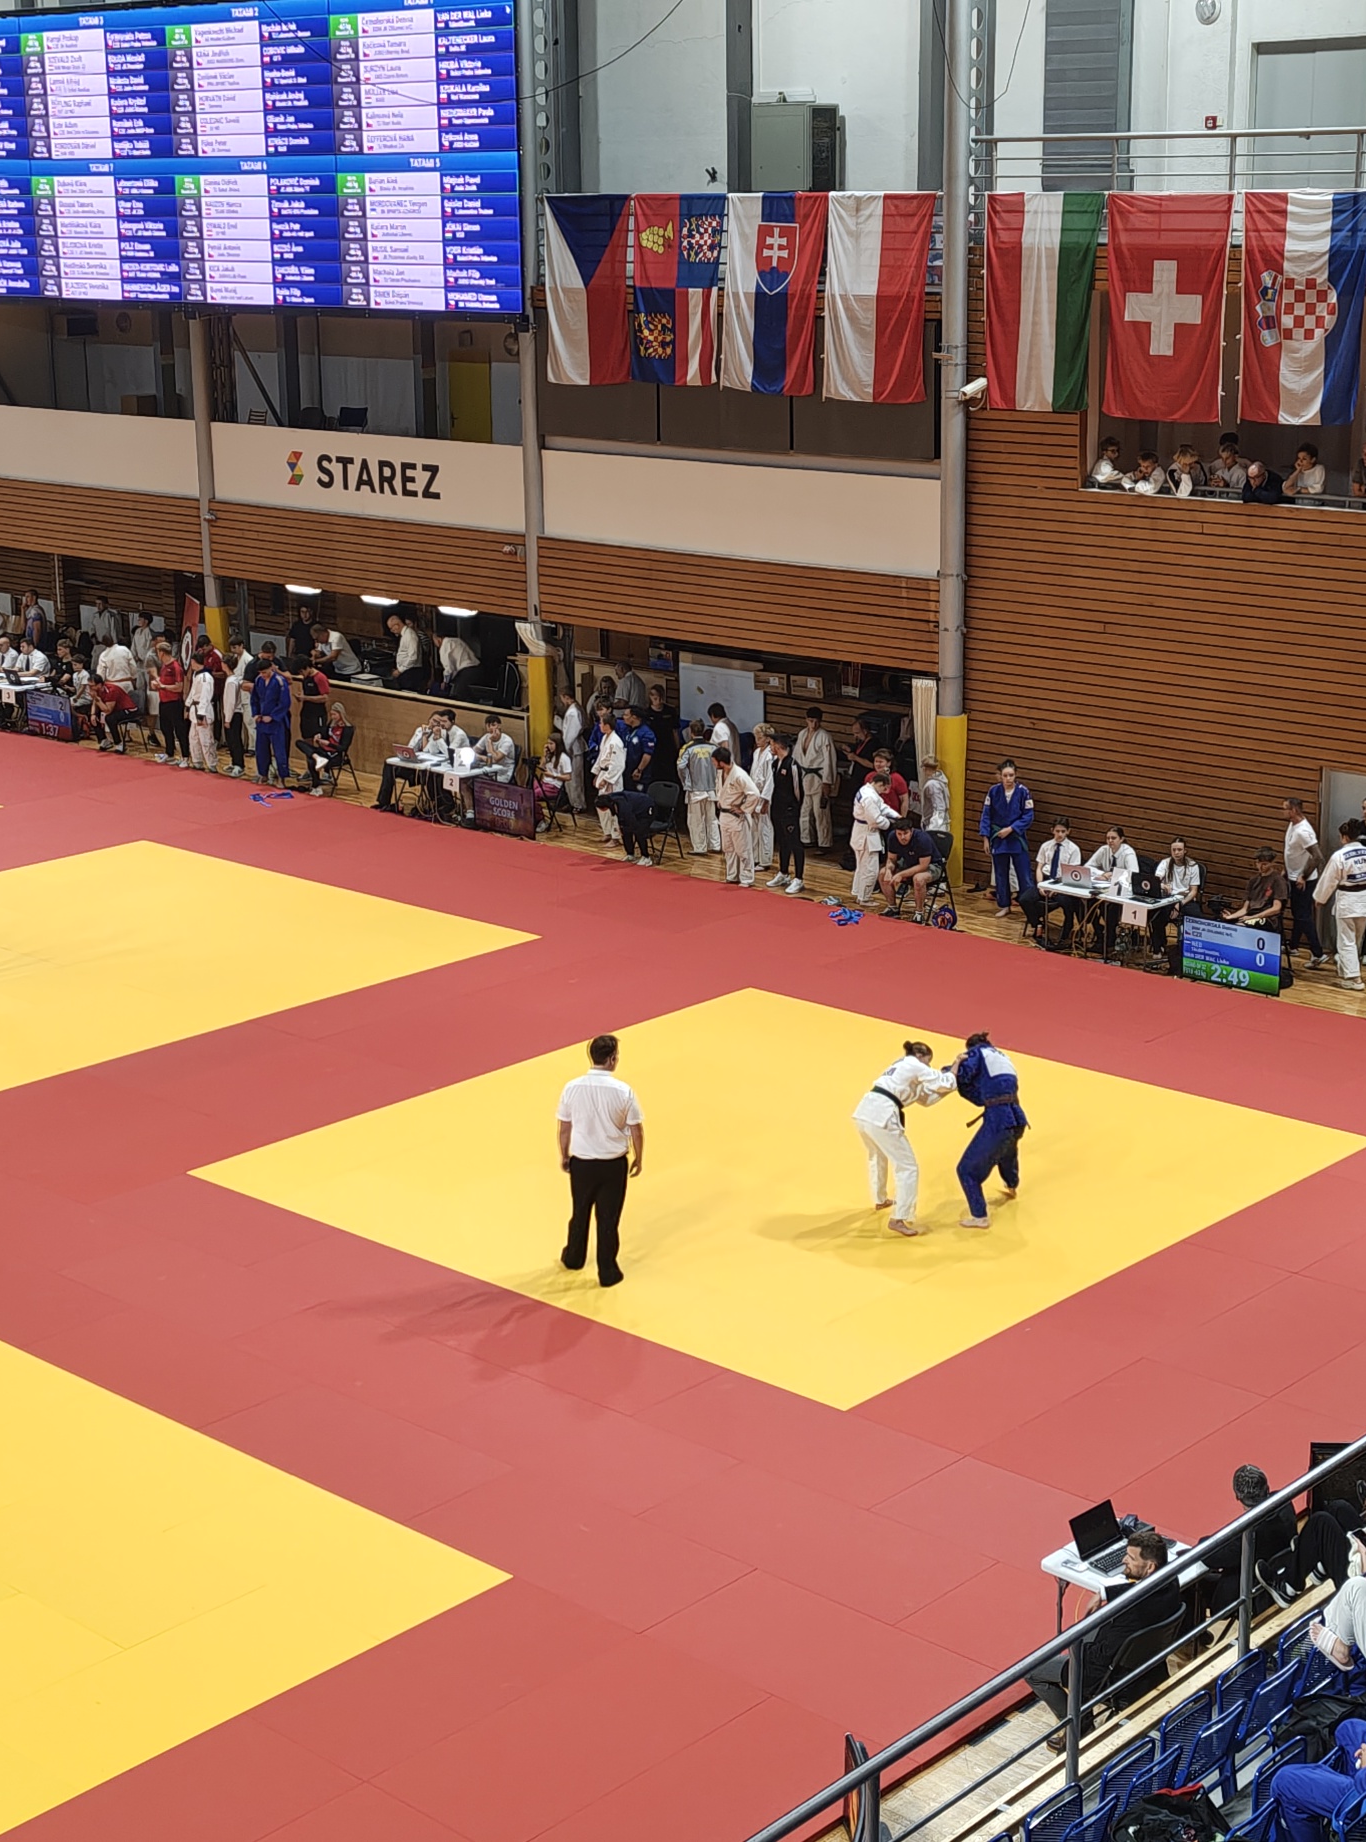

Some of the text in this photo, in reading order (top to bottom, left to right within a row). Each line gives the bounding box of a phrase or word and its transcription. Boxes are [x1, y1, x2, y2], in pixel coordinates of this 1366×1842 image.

[410, 158, 434, 168] TATAMI
[316, 454, 441, 500] STAREZ
[41, 723, 59, 737] 1:37
[449, 779, 454, 787] 2
[489, 796, 519, 810] GOLDEN
[493, 807, 515, 818] SCORE
[1257, 937, 1265, 950] 0
[1256, 953, 1265, 967] 0
[1211, 964, 1250, 987] 2:49
